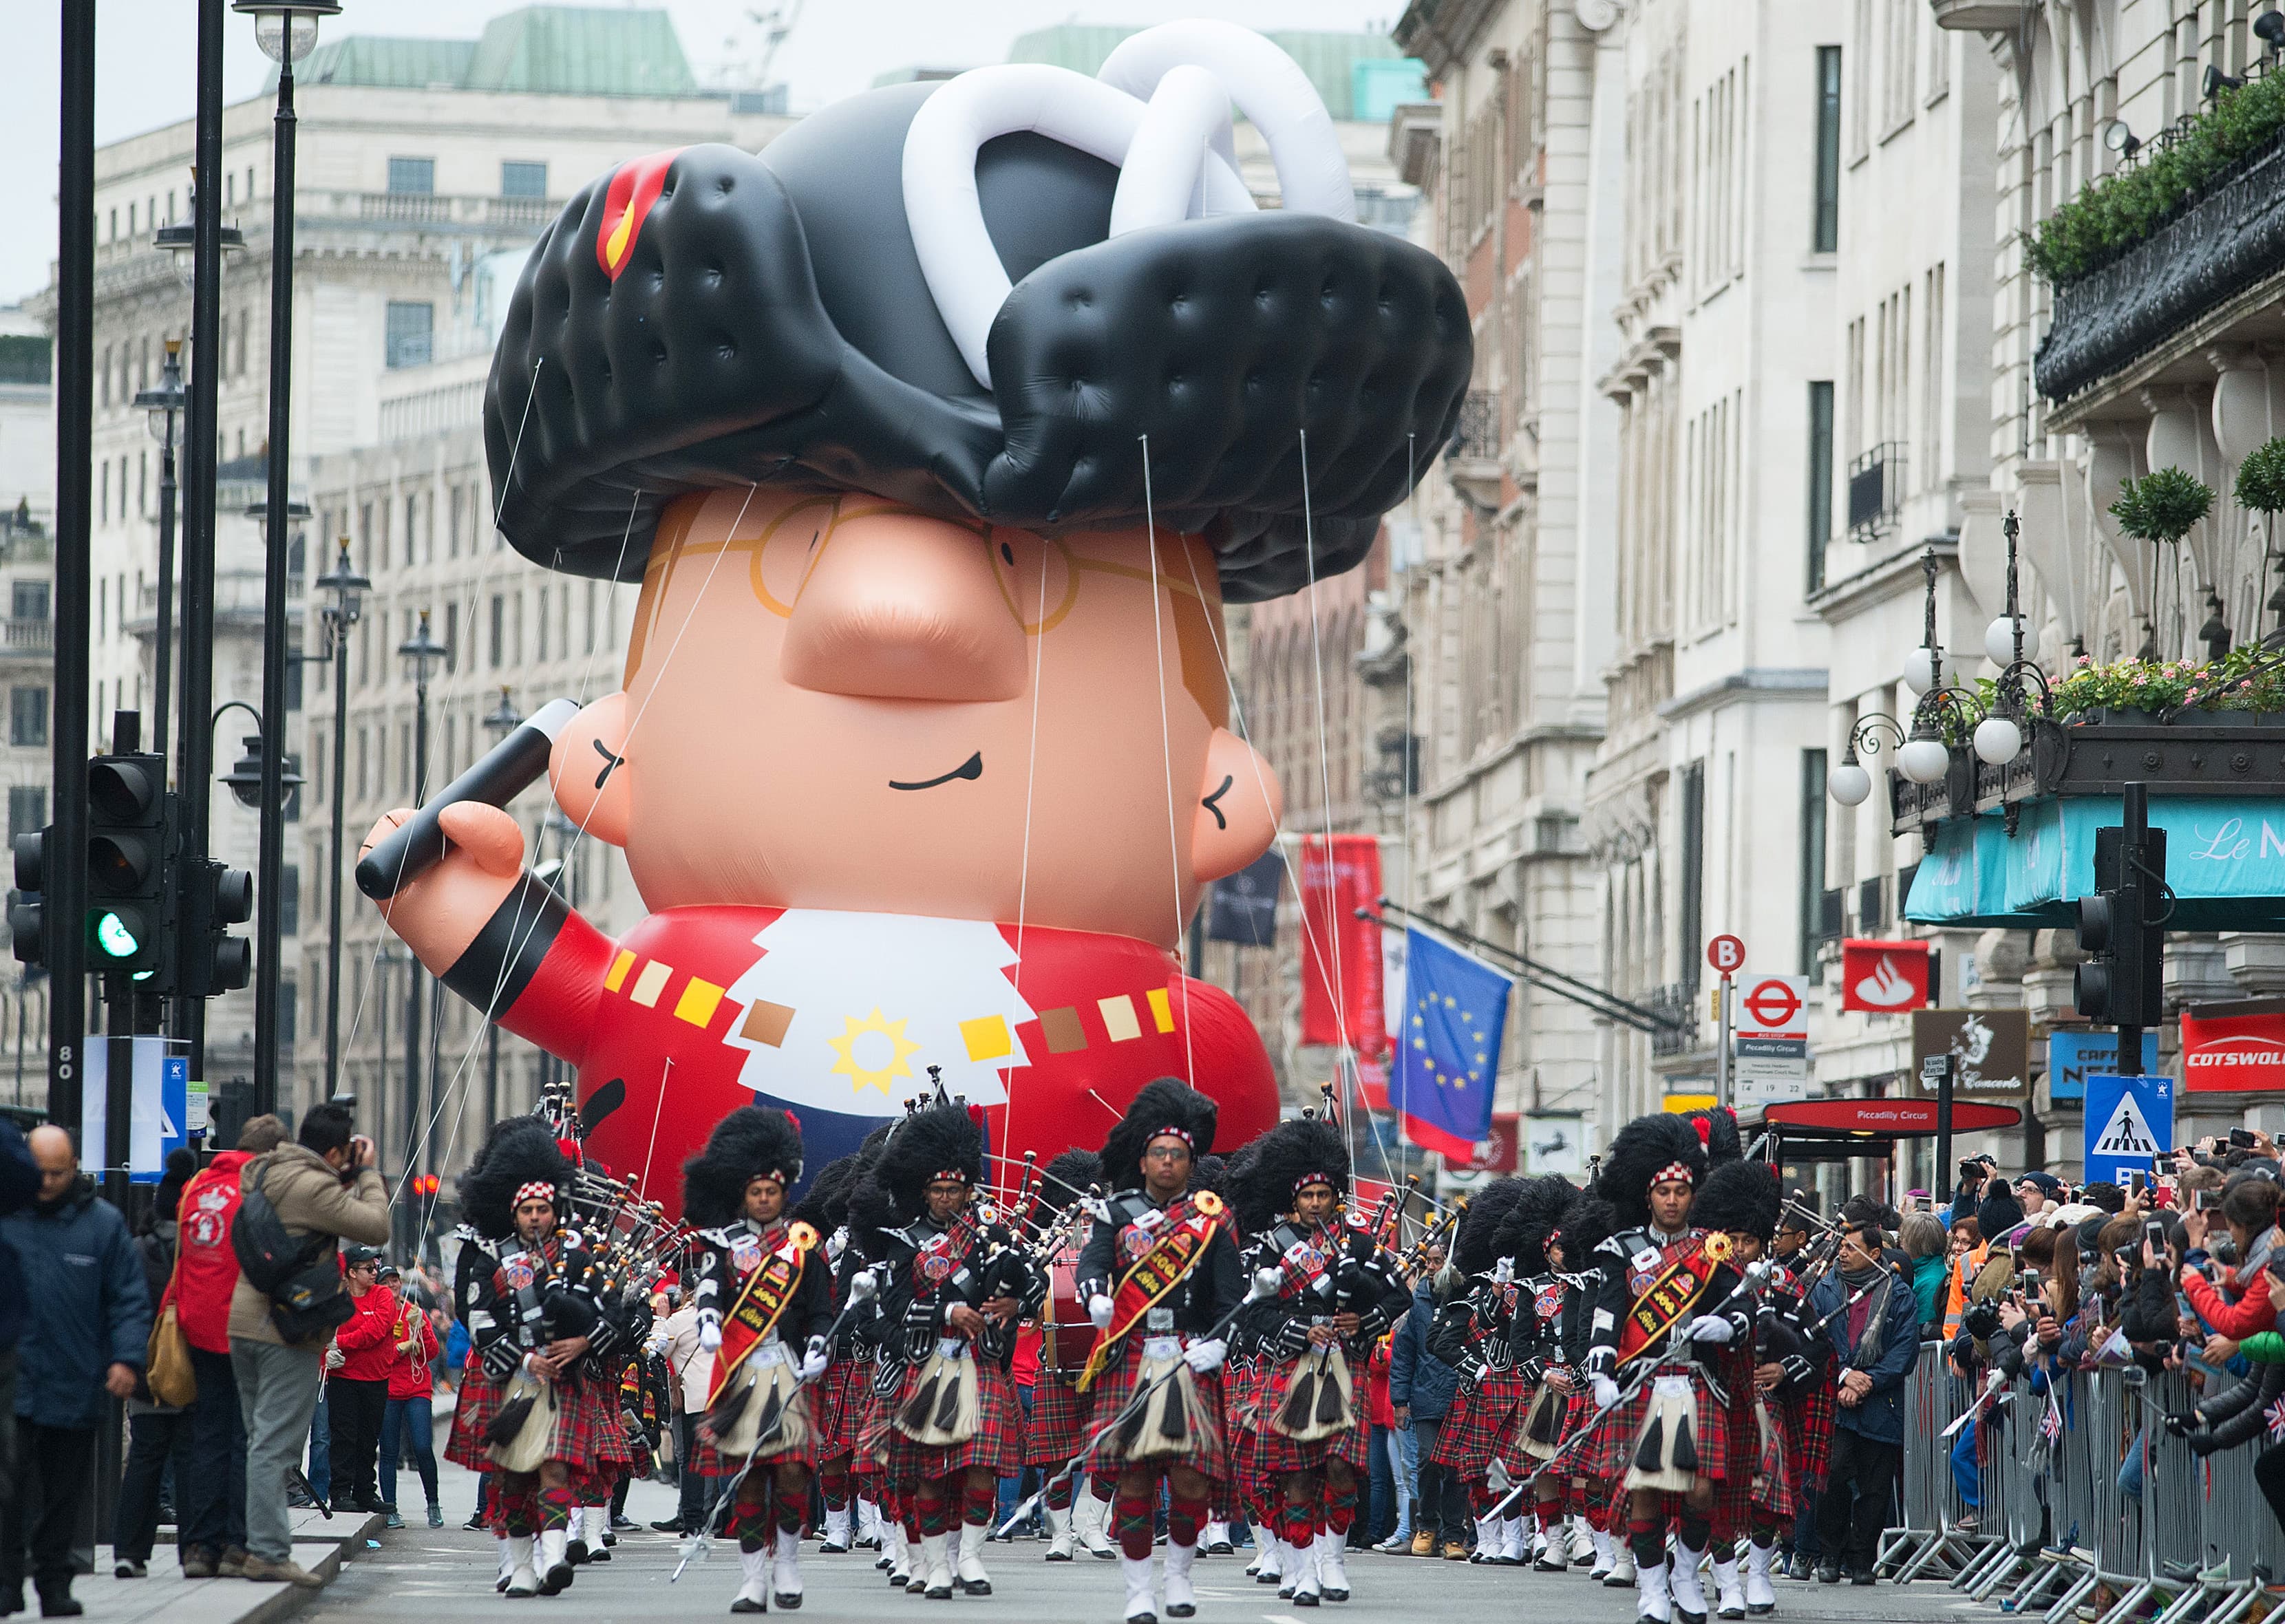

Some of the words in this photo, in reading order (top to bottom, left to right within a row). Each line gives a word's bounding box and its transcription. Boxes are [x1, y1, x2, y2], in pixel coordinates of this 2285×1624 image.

[2189, 818, 2251, 860] Le
[1718, 940, 1738, 966] B
[1745, 1044, 1775, 1053] Piccadilly
[2187, 1051, 2285, 1067] COTSWOL
[1857, 1110, 1898, 1120] Piccadilly
[1900, 1111, 1928, 1120] Circus
